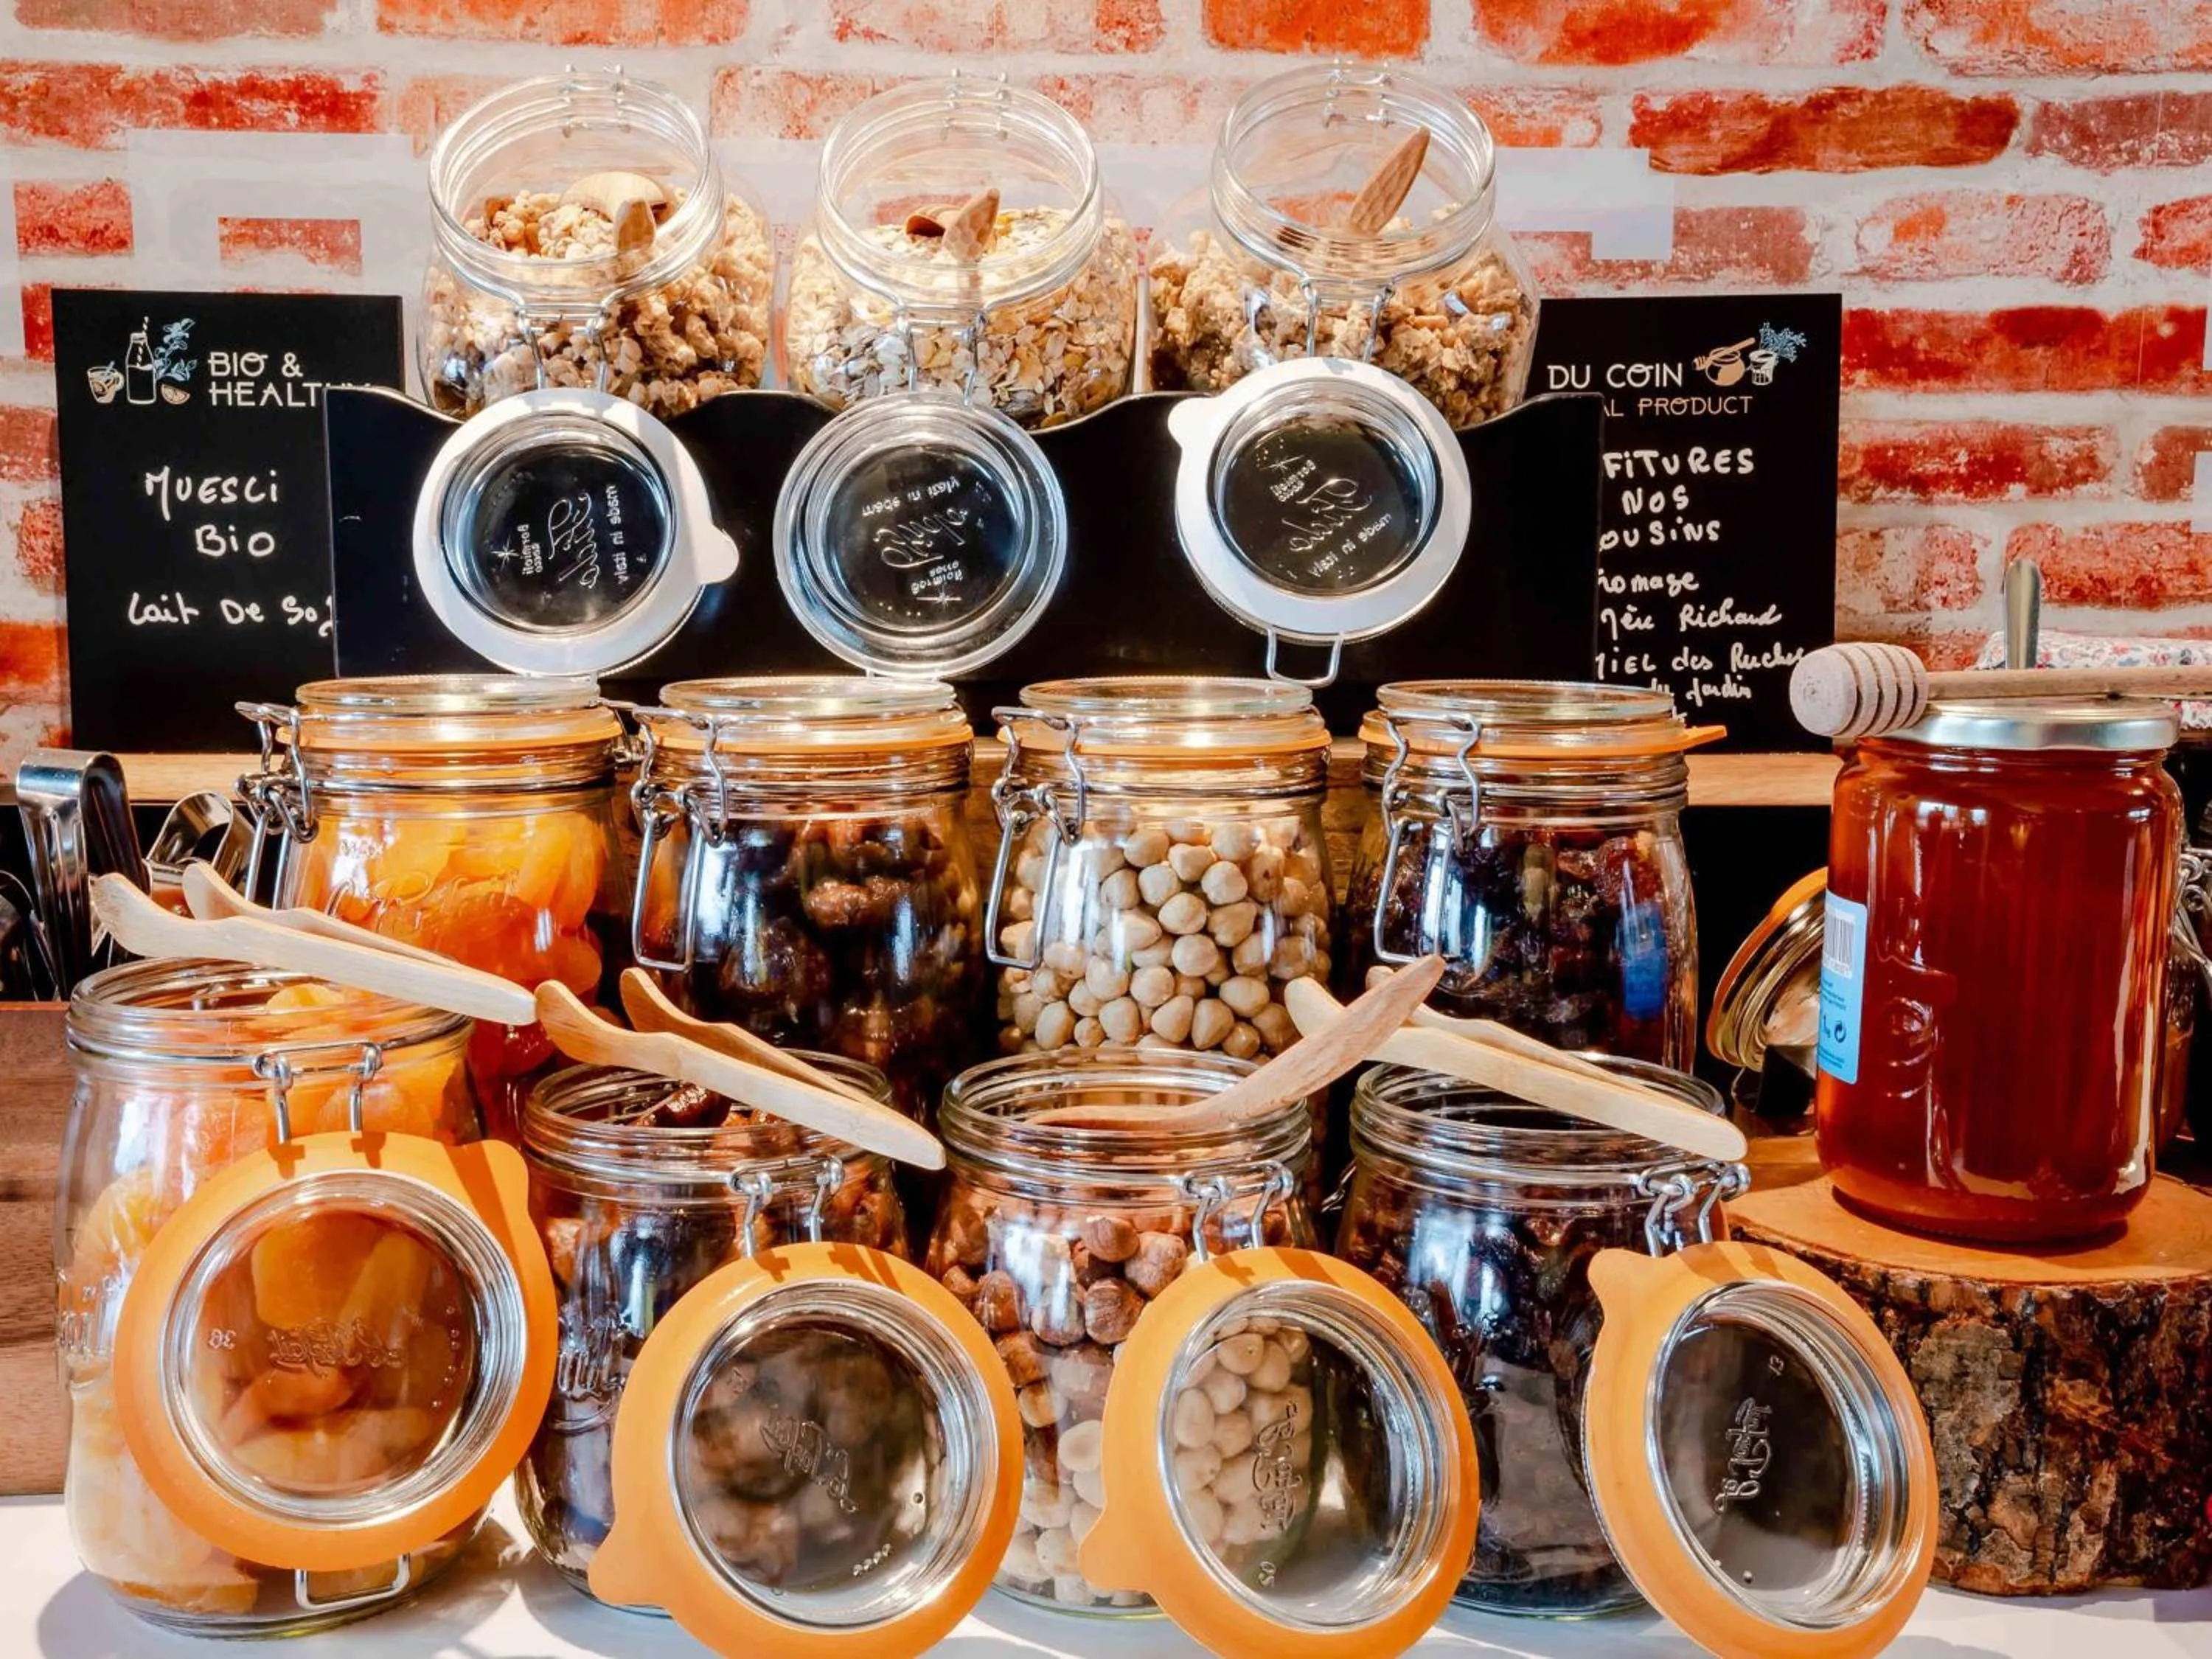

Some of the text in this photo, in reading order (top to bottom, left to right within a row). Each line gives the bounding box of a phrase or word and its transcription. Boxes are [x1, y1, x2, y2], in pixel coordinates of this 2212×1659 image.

[208, 352, 304, 378] BIO &
[1548, 363, 1683, 389] DU COIN
[209, 380, 369, 406] HEALT
[1638, 396, 1753, 417] PRODUCT
[1621, 484, 1689, 515] NOS
[128, 592, 200, 625] Lait
[220, 599, 265, 625] De
[1679, 597, 1782, 632] Richard
[1672, 646, 1713, 671] des
